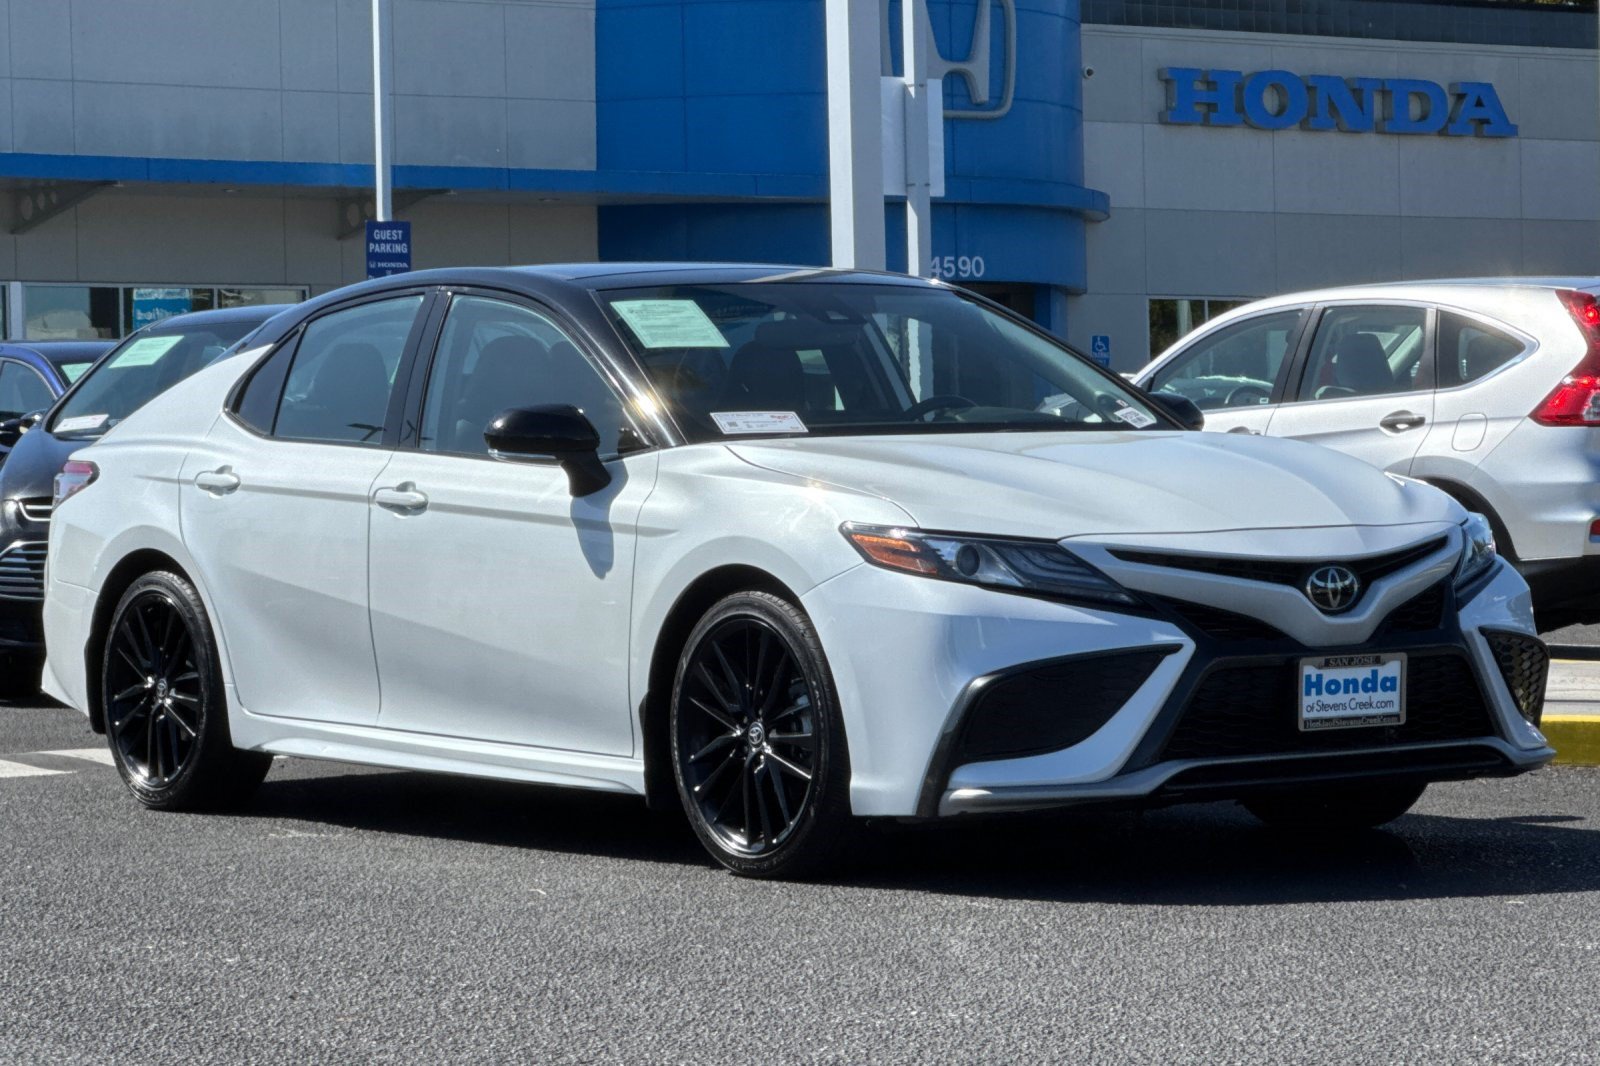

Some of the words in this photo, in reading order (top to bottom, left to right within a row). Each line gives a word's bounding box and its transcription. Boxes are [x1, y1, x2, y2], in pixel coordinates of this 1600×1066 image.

[1159, 66, 1518, 138] HONDA
[373, 229, 403, 240] GUEST
[369, 242, 408, 253] PARKING
[929, 255, 985, 278] 4590
[1328, 657, 1349, 667] SAN
[1351, 655, 1377, 665] JOSE
[1304, 669, 1397, 697] Honda
[1306, 702, 1315, 713] of
[1316, 699, 1347, 712] Stevens
[1348, 696, 1394, 711] Creek.com
